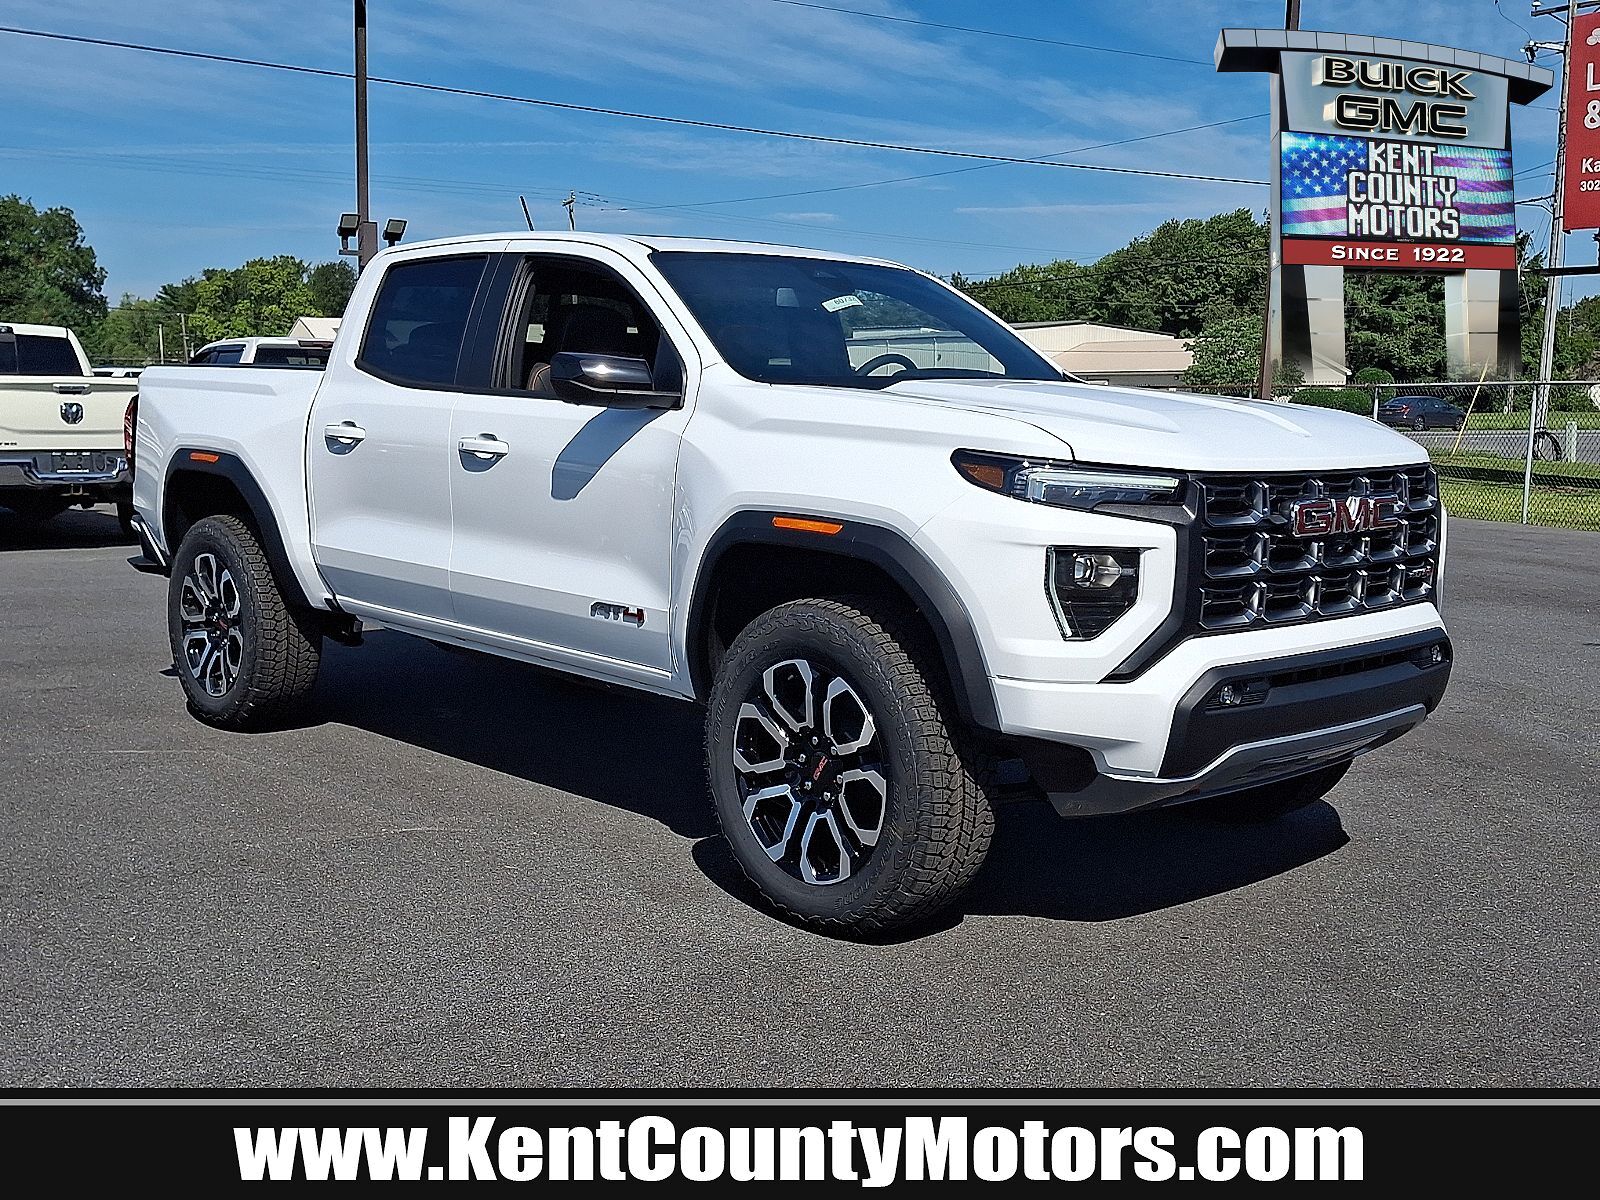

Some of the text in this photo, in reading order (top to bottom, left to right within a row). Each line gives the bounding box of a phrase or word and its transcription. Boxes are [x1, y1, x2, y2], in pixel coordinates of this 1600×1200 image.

[1322, 54, 1477, 99] BUICK
[1335, 93, 1469, 137] GMC
[1368, 141, 1436, 176] KENT
[1348, 171, 1456, 208] COUNTY
[1348, 203, 1460, 239] MOTORS
[1413, 247, 1465, 263] 1922
[1291, 494, 1399, 538] GMC
[590, 602, 645, 628] AT4
